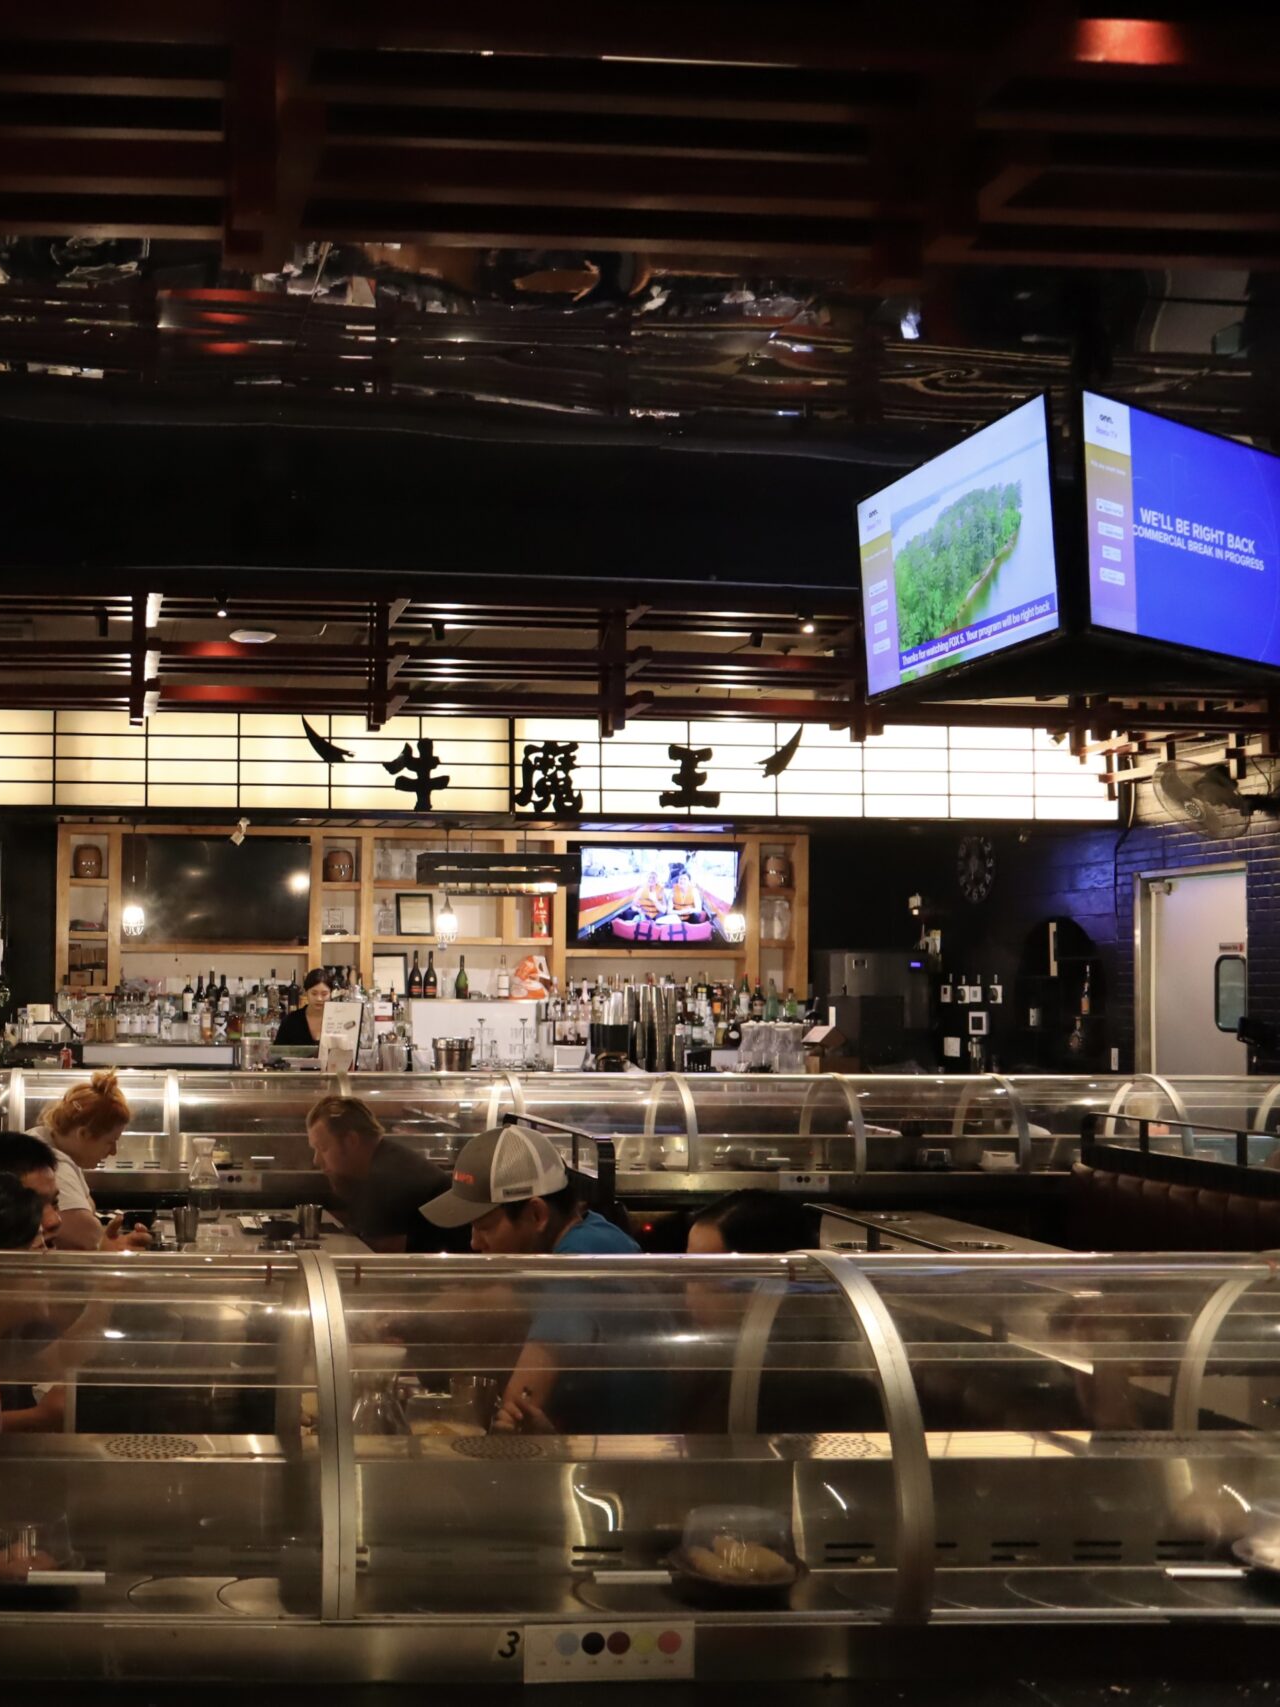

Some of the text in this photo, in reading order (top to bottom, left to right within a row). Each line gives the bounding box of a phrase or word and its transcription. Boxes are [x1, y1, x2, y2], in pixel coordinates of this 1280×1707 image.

[1132, 524, 1186, 550] COMMERCIAL
[1187, 540, 1214, 557] BREAK
[1215, 548, 1223, 560] IN
[1224, 550, 1265, 571] PROGRESS
[1139, 507, 1174, 532] WE'LL
[1175, 517, 1190, 536] BE
[1192, 522, 1225, 546] RIGHT
[1227, 532, 1256, 555] BACK
[902, 649, 919, 666] Thanks
[918, 648, 927, 660] for
[926, 641, 949, 658] watching
[948, 636, 960, 648] FOX
[966, 630, 978, 643] Your
[978, 621, 1002, 640] program
[1002, 615, 1013, 629] will
[1013, 613, 1020, 624] be
[1020, 607, 1035, 624] right
[1035, 601, 1051, 616] back
[382, 738, 721, 814] 牛魔王
[498, 1631, 521, 1659] 3
